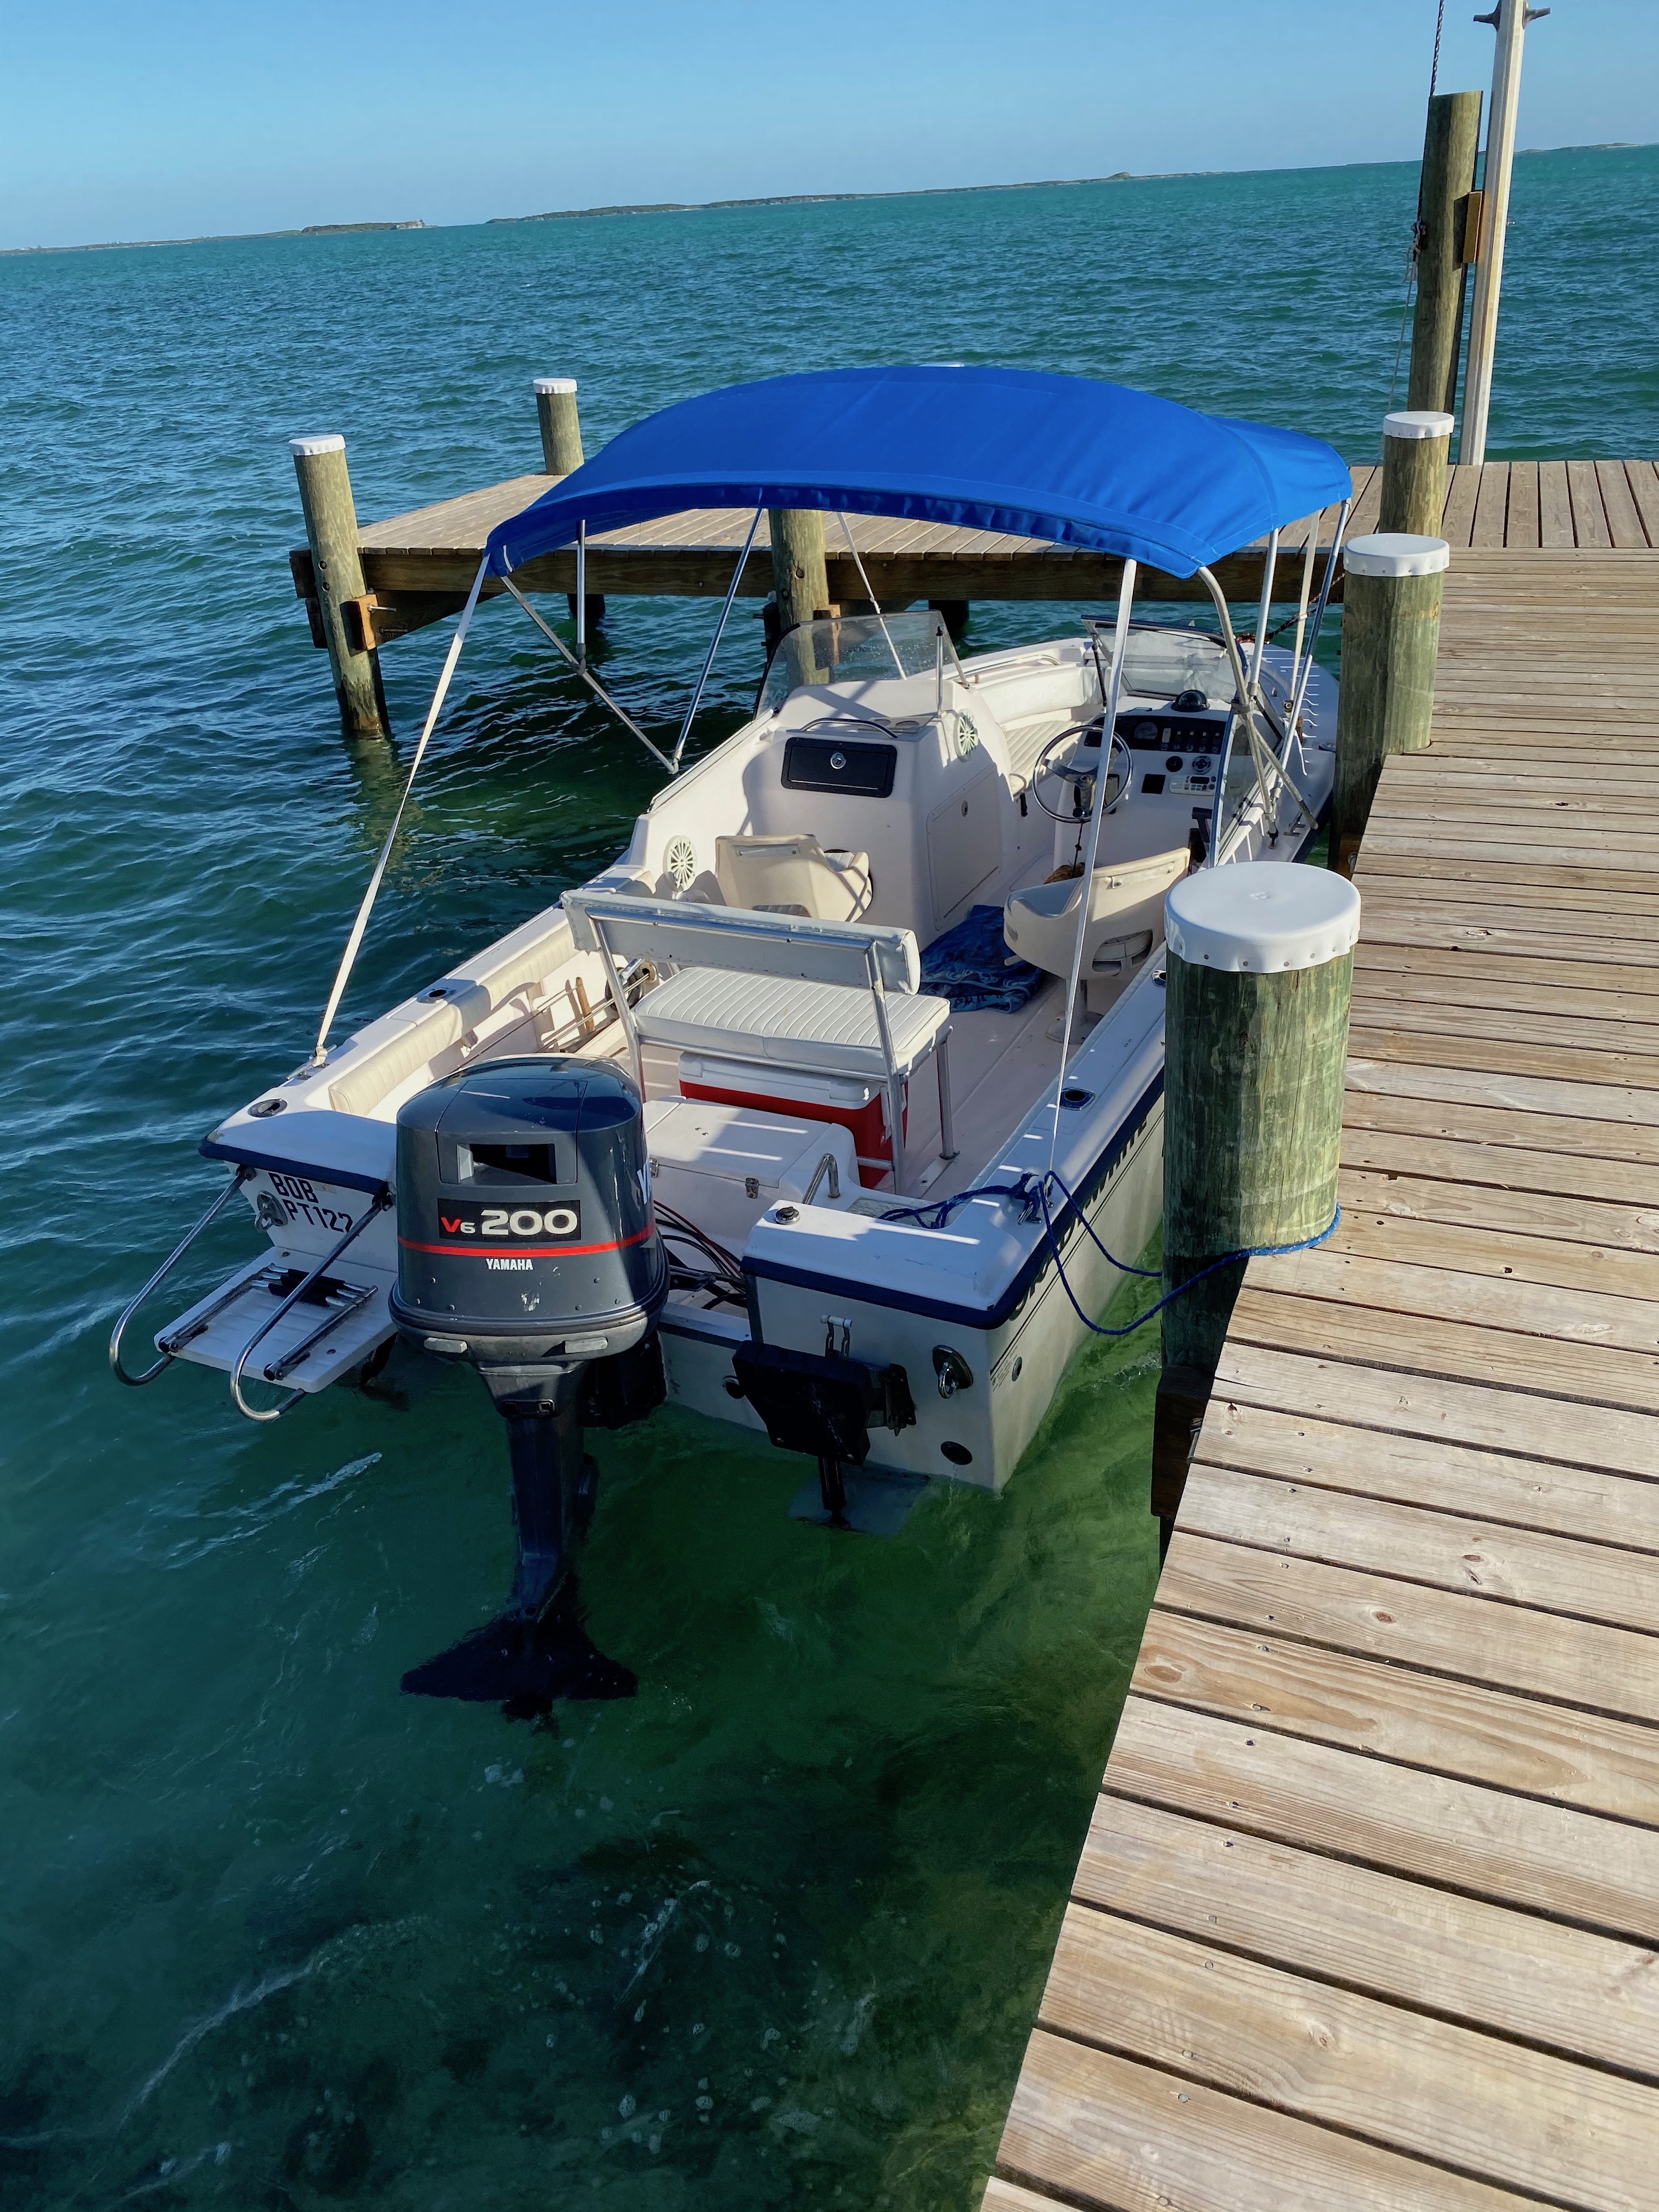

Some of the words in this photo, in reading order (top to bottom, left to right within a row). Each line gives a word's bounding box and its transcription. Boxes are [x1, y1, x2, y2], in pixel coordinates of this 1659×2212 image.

[268, 1172, 319, 1204] BOB
[441, 1217, 476, 1234] V6
[481, 1209, 578, 1235] 200
[486, 1258, 534, 1271] YAMAHA
